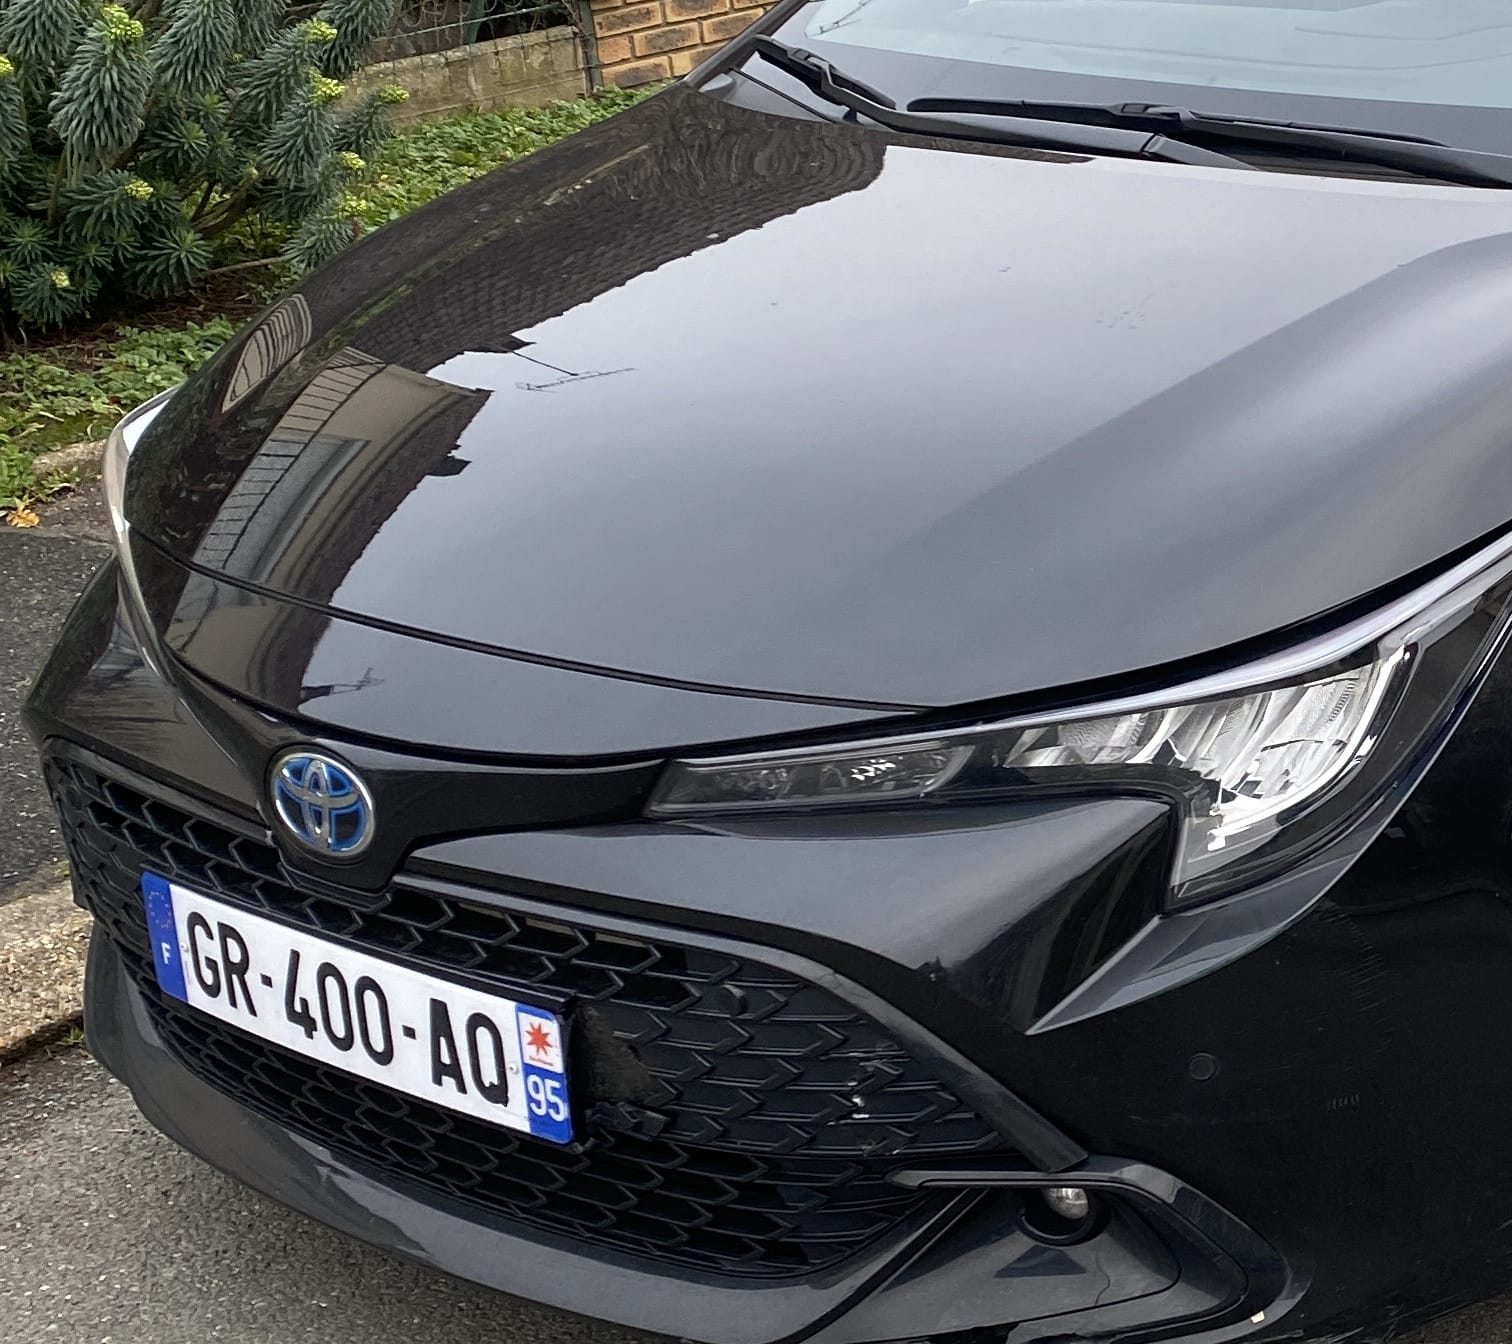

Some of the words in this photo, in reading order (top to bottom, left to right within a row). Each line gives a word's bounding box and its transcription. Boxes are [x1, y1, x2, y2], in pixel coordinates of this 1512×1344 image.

[161, 941, 171, 965] F
[186, 910, 509, 1107] GR-400-AQ
[526, 1074, 565, 1122] 95
